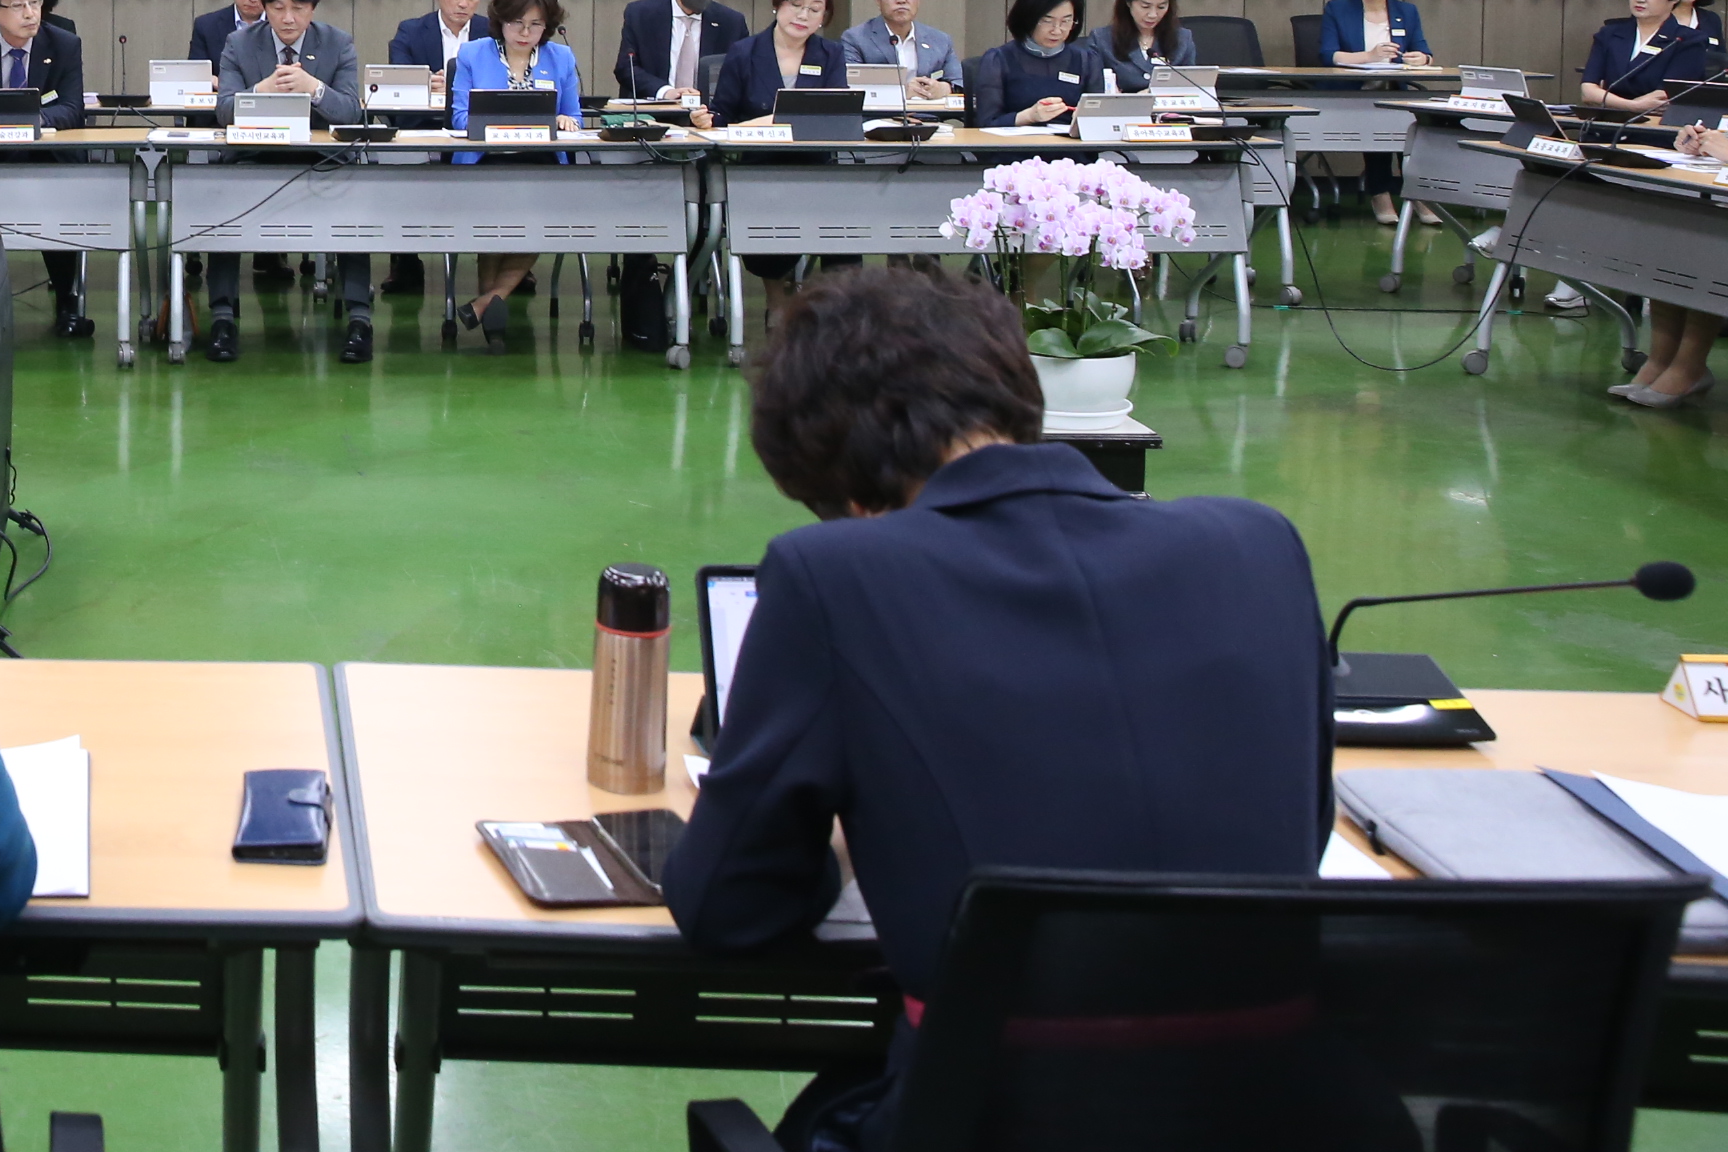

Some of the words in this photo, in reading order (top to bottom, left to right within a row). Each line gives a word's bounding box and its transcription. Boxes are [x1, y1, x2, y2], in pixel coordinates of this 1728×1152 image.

[232, 131, 286, 140] 민주시민교육과
[491, 131, 544, 139] 교육복지과
[734, 129, 786, 138] 학교혁신과
[1133, 129, 1186, 138] 유아특수교육과
